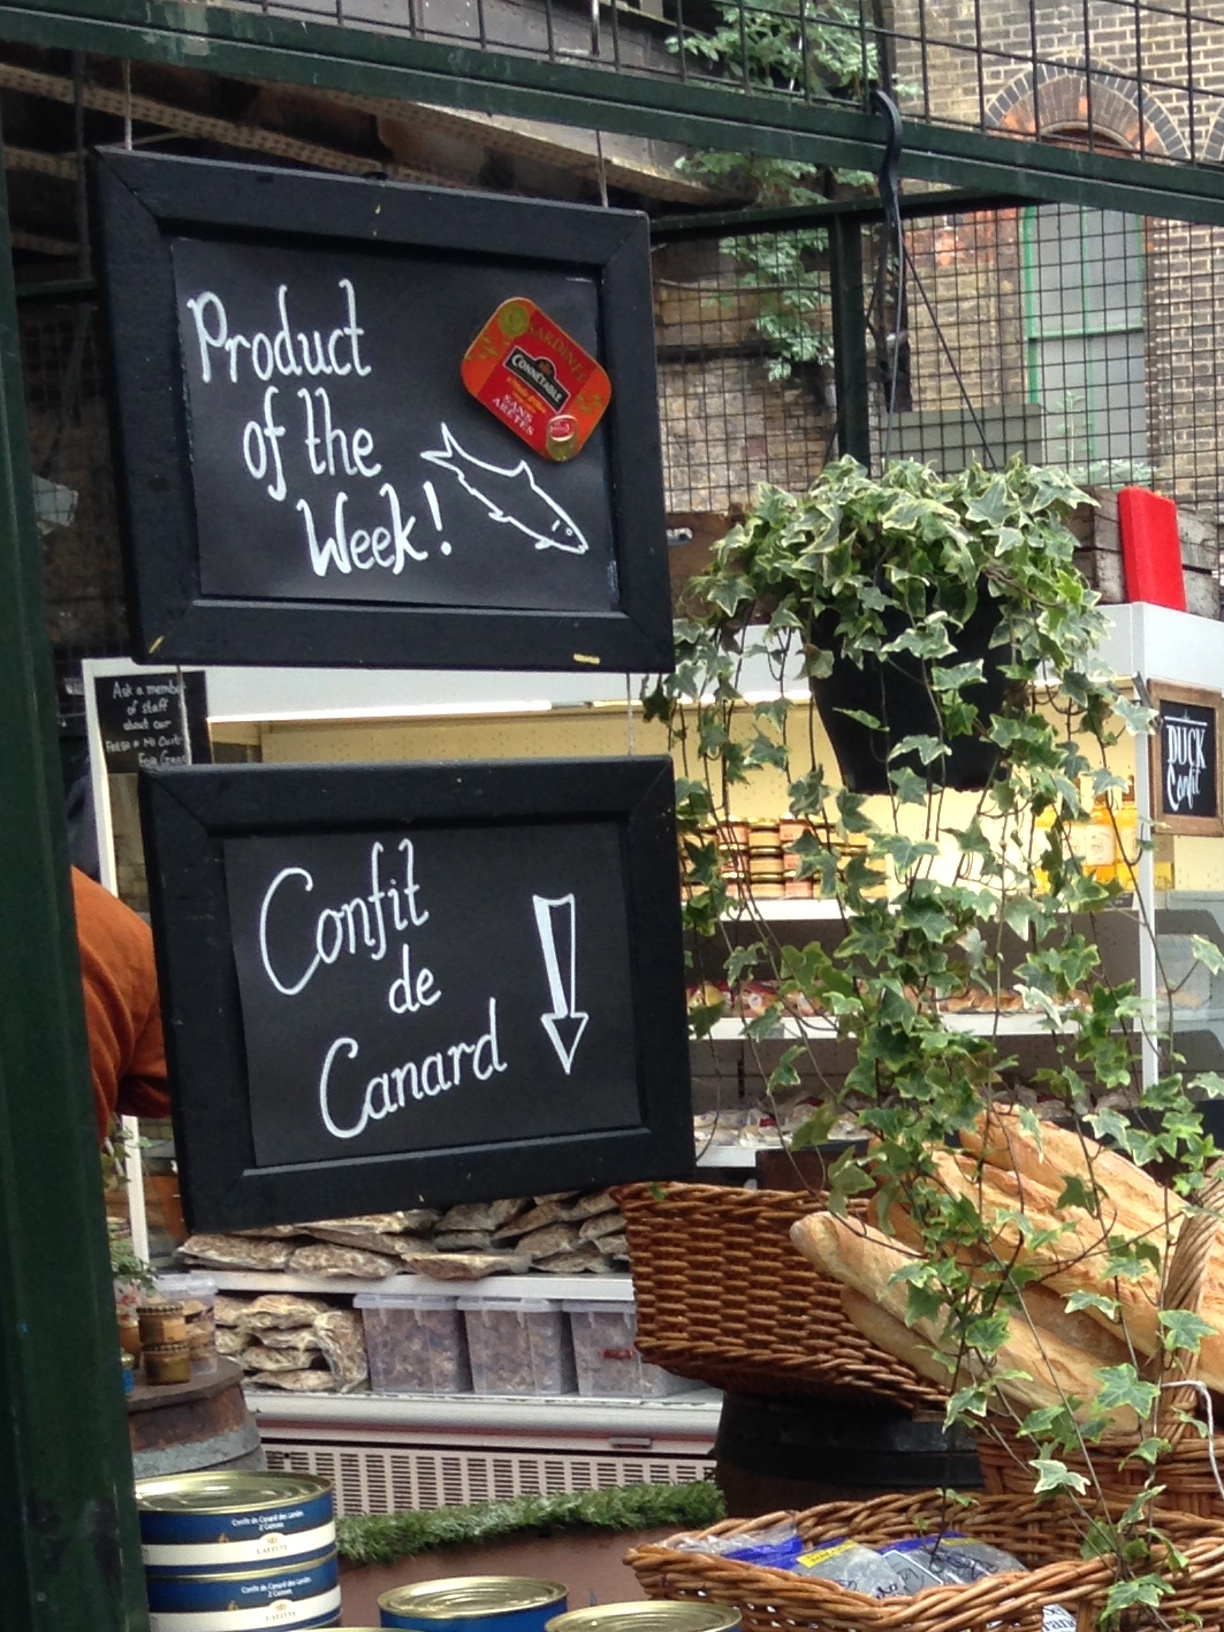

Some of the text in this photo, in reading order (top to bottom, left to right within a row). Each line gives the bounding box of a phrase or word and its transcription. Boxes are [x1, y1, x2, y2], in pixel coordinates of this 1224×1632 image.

[187, 278, 372, 383] Product
[243, 386, 382, 500] of the
[503, 393, 534, 423] SANS
[297, 481, 452, 577] Week!
[1166, 724, 1207, 769] DUCK
[1167, 763, 1201, 811] Confit
[260, 839, 429, 995] Confit
[389, 943, 442, 1014] de
[319, 997, 507, 1139] Canard
